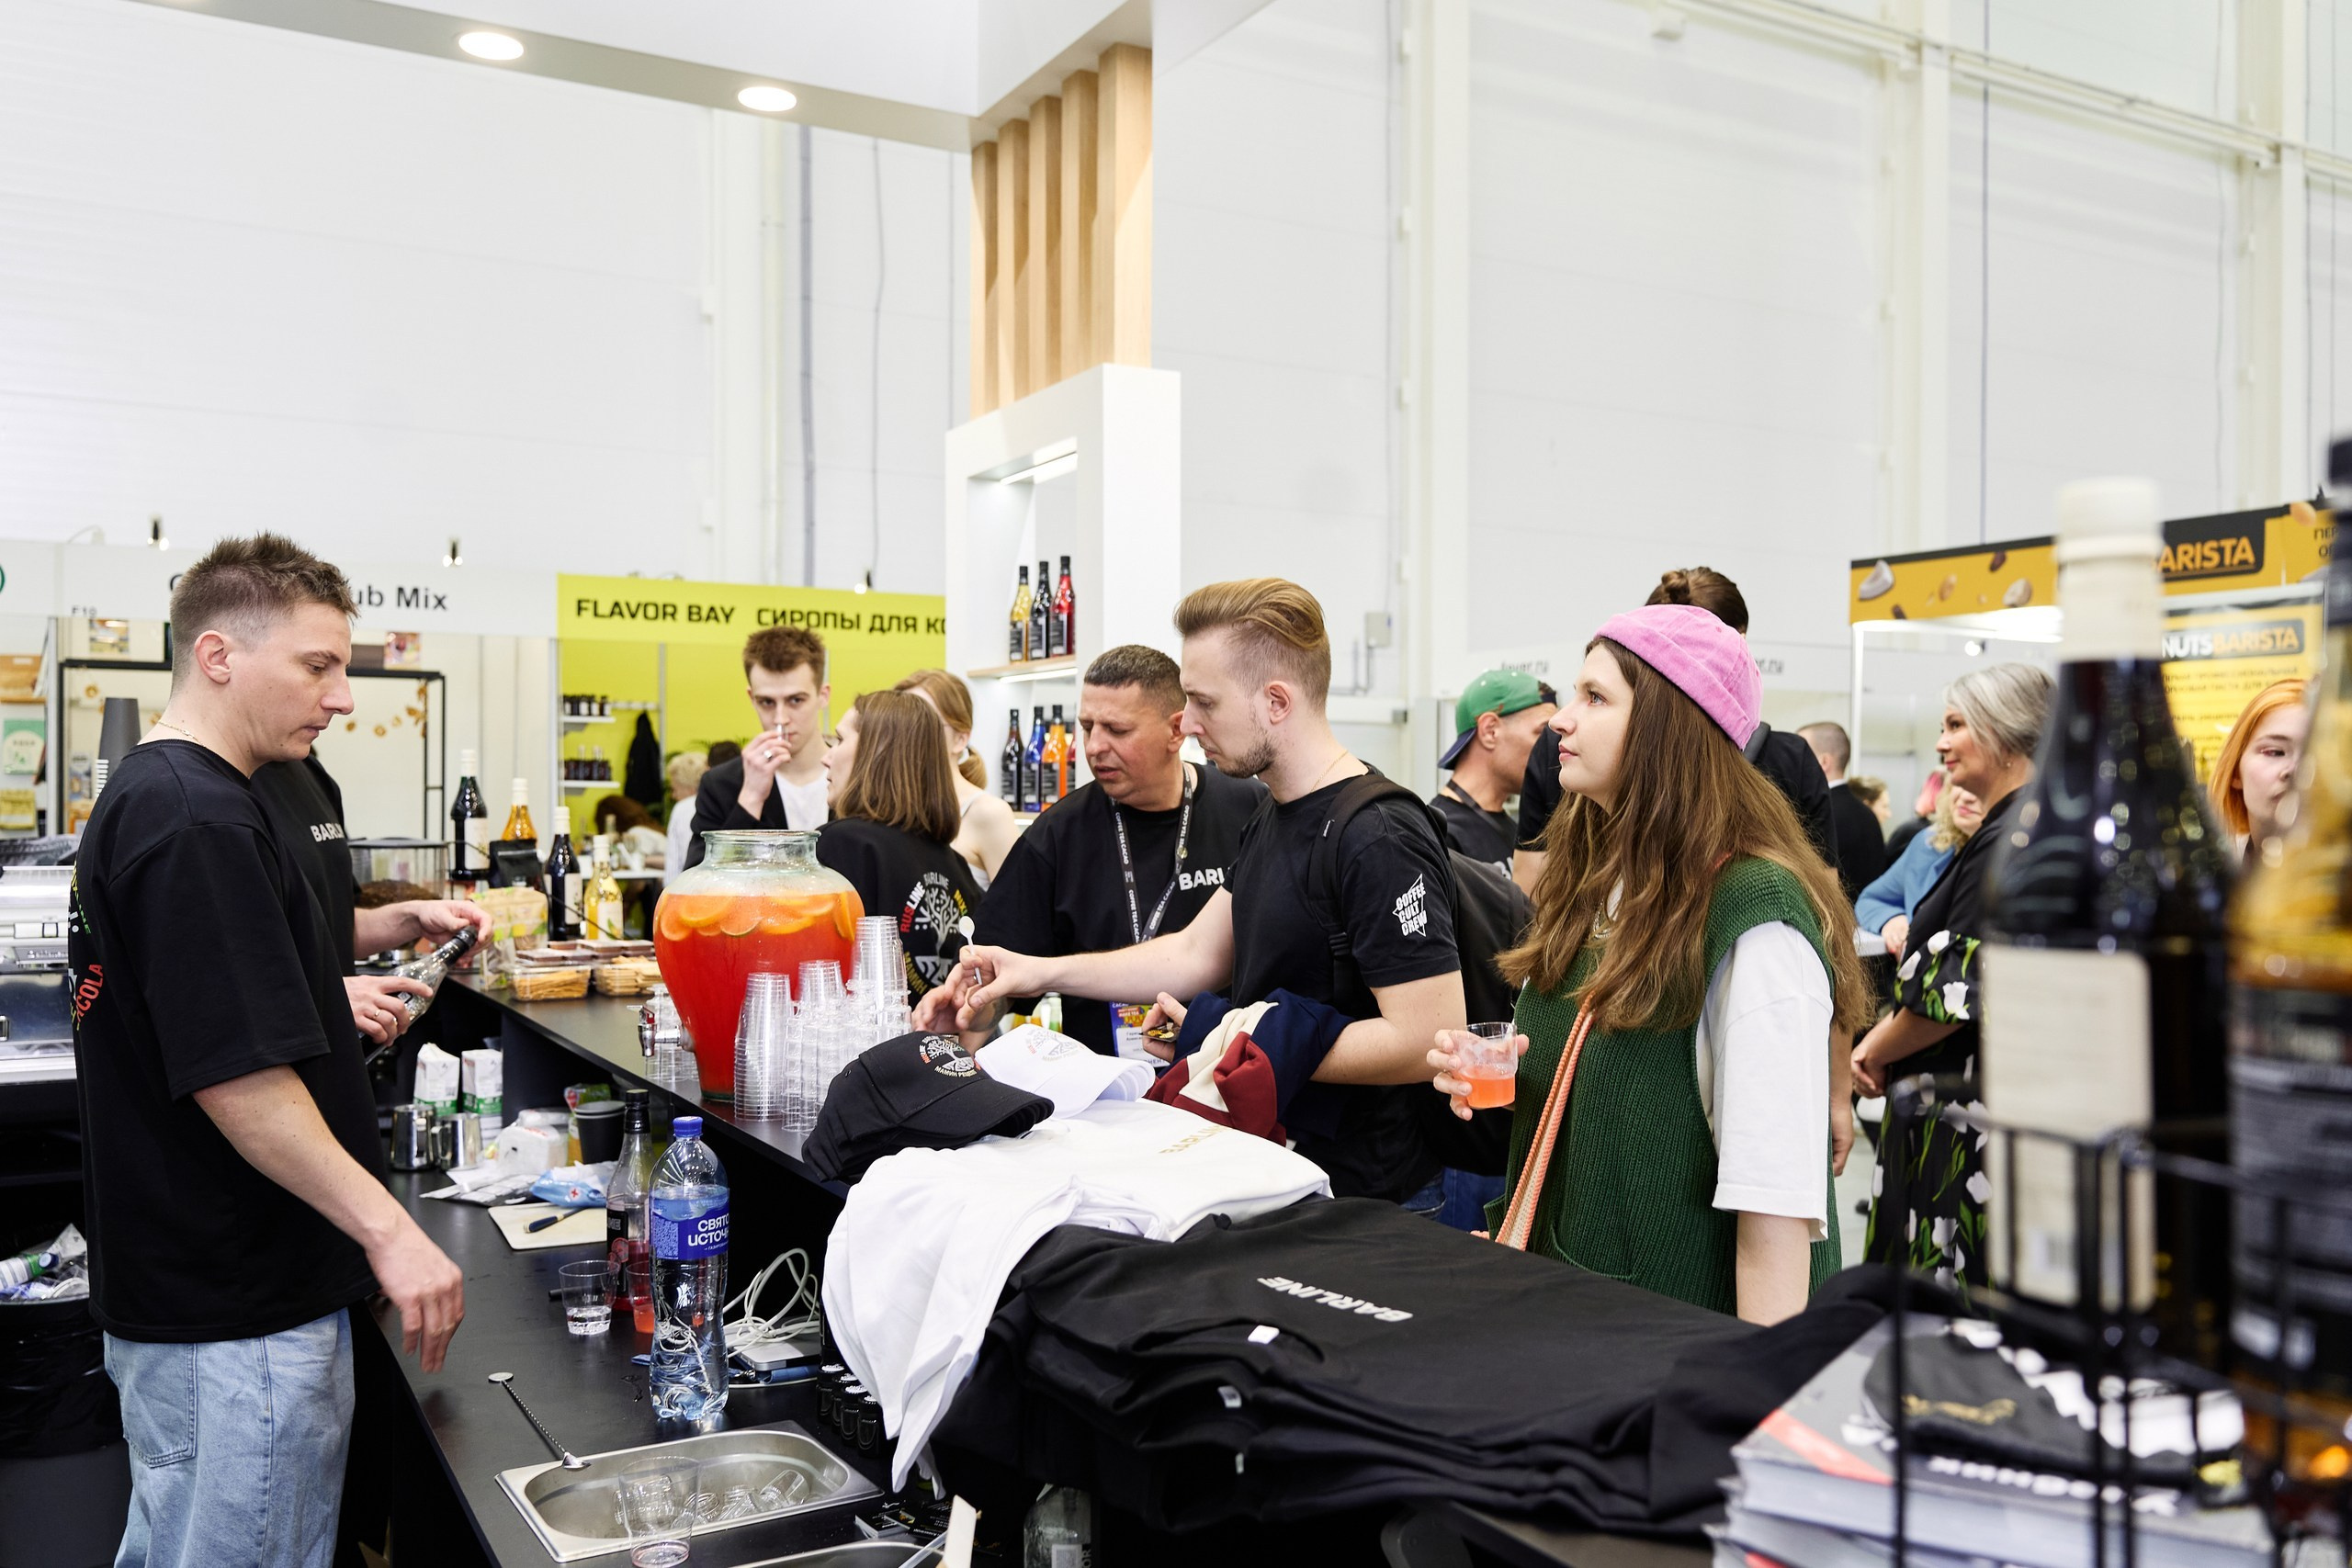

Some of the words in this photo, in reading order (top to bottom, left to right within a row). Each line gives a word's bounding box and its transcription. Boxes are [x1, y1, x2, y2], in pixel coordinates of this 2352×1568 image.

[2155, 536, 2256, 571] ARISTA
[397, 587, 447, 610] Mix
[576, 599, 678, 622] FLAVOR
[687, 604, 736, 625] BAY
[757, 607, 861, 631] СИРОПЫ
[869, 614, 918, 635] ДЛЯ
[1396, 882, 1426, 911] COFFEE
[1398, 901, 1420, 923] CULT
[1401, 909, 1428, 936] CREW
[1256, 1276, 1413, 1322] BARLINE
